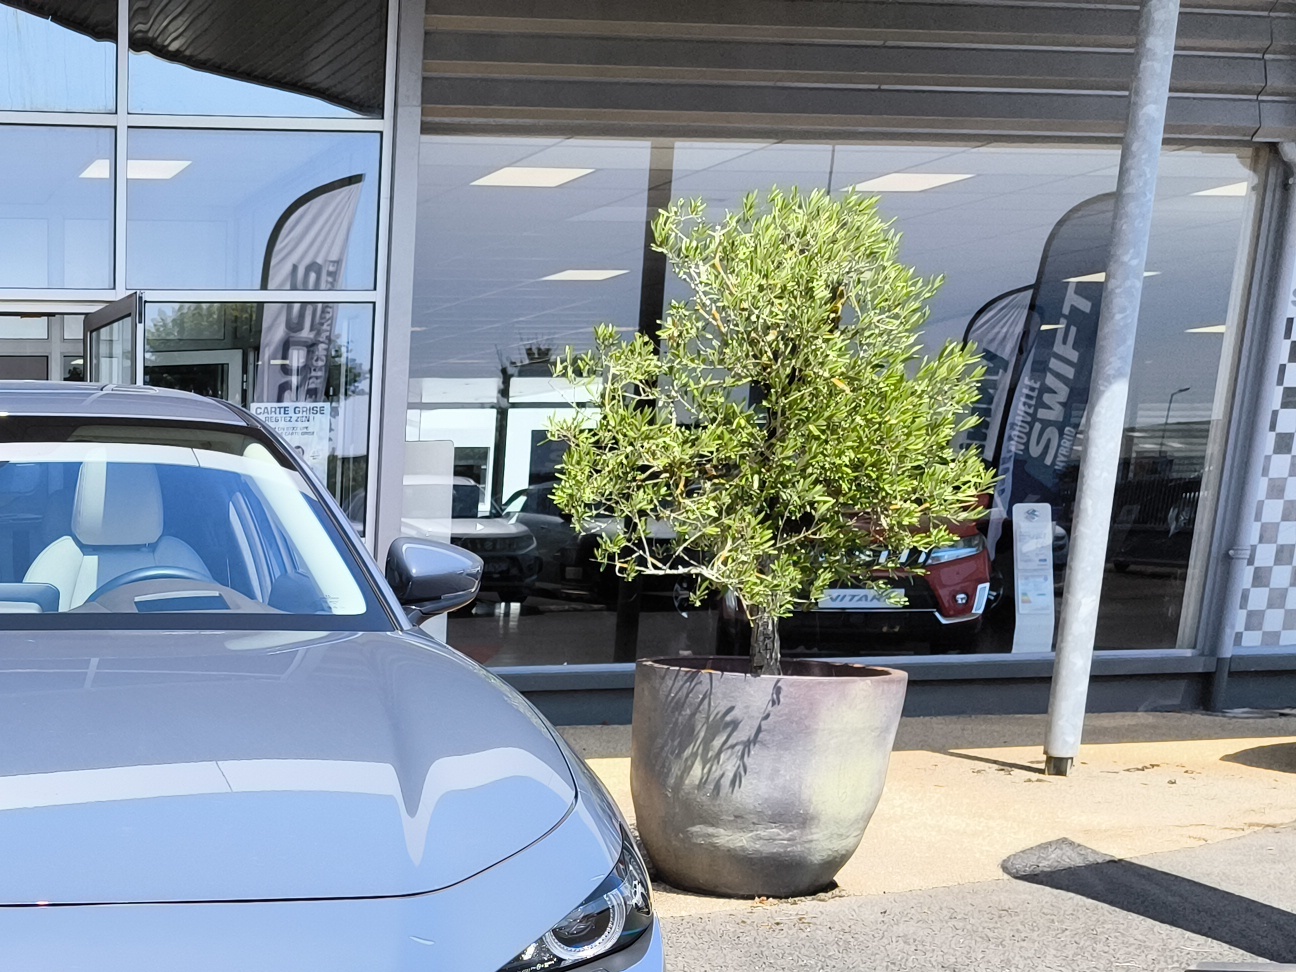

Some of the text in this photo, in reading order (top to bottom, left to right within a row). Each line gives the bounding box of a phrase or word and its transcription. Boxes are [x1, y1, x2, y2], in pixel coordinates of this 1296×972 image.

[1029, 281, 1092, 466] SWIFT
[255, 406, 325, 415] CARTE GRISE
[1009, 376, 1041, 454] NOUVELLE
[1055, 426, 1077, 474] HYBRID
